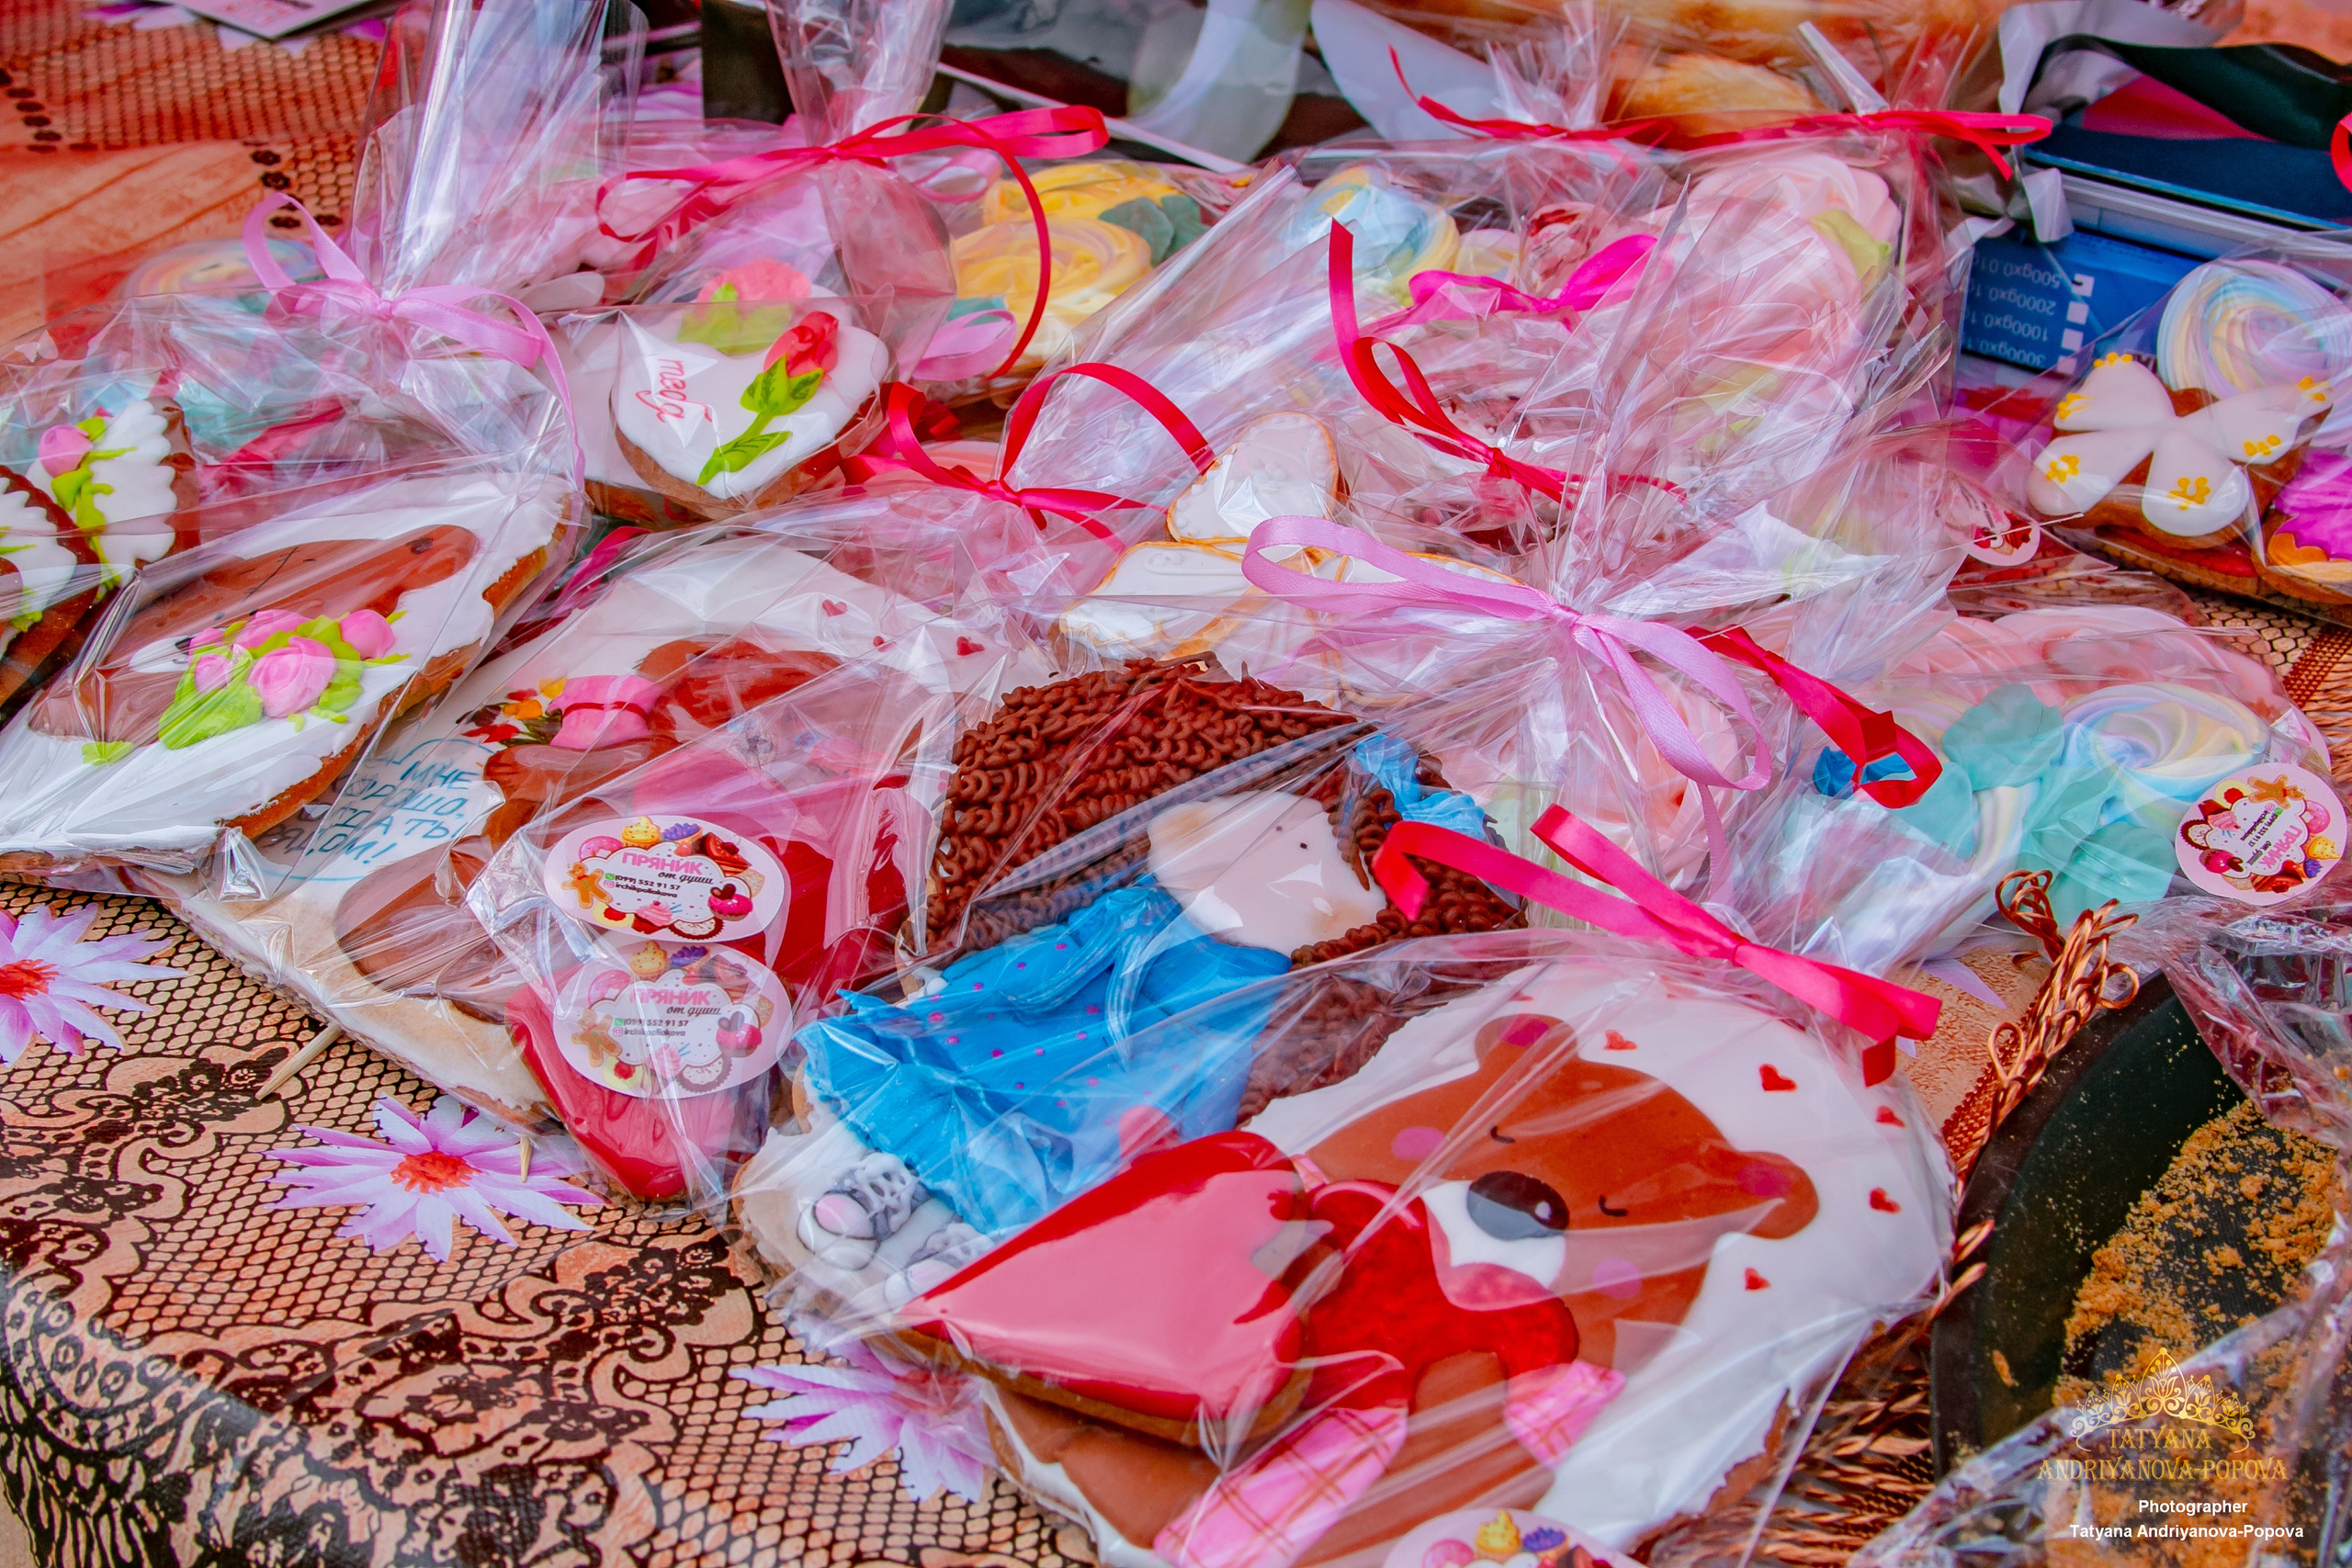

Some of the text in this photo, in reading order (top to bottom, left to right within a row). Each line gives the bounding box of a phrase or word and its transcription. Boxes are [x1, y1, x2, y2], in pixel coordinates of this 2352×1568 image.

[2258, 825, 2302, 869] ПРЯНИК
[621, 852, 704, 875] ПРЯНИК
[615, 874, 637, 885] (099)
[638, 879, 655, 887] 552
[679, 874, 715, 885] души
[628, 987, 712, 1006] ПРЯНИК
[666, 1006, 722, 1017] от души
[647, 1019, 663, 1027] 552
